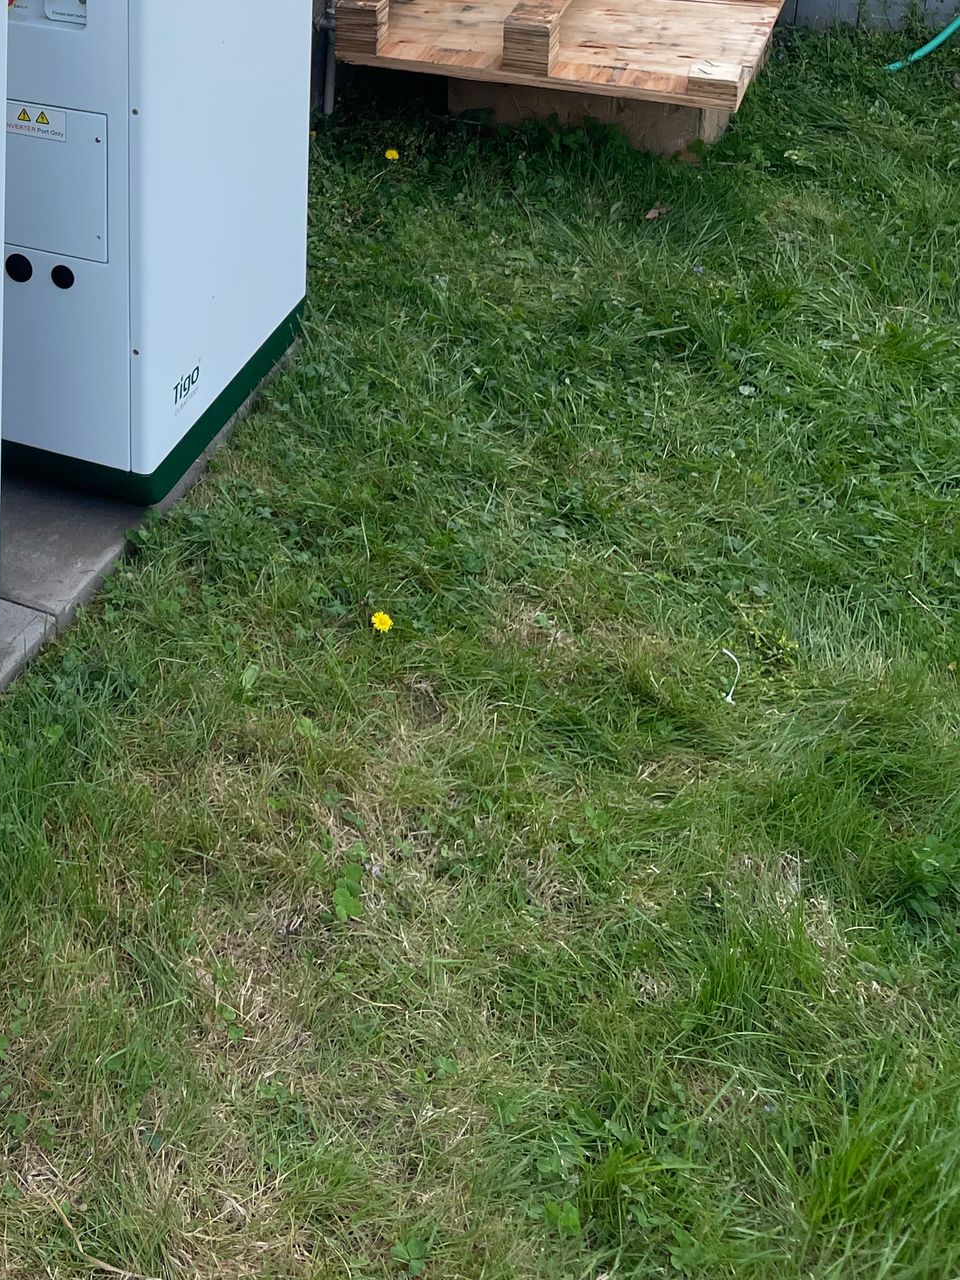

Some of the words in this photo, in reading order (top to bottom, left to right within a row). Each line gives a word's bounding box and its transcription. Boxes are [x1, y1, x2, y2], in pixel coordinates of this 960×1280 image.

[7, 122, 36, 133] NVERTER
[36, 127, 50, 136] Port
[50, 129, 65, 139] Only
[172, 365, 200, 406] Tigo
